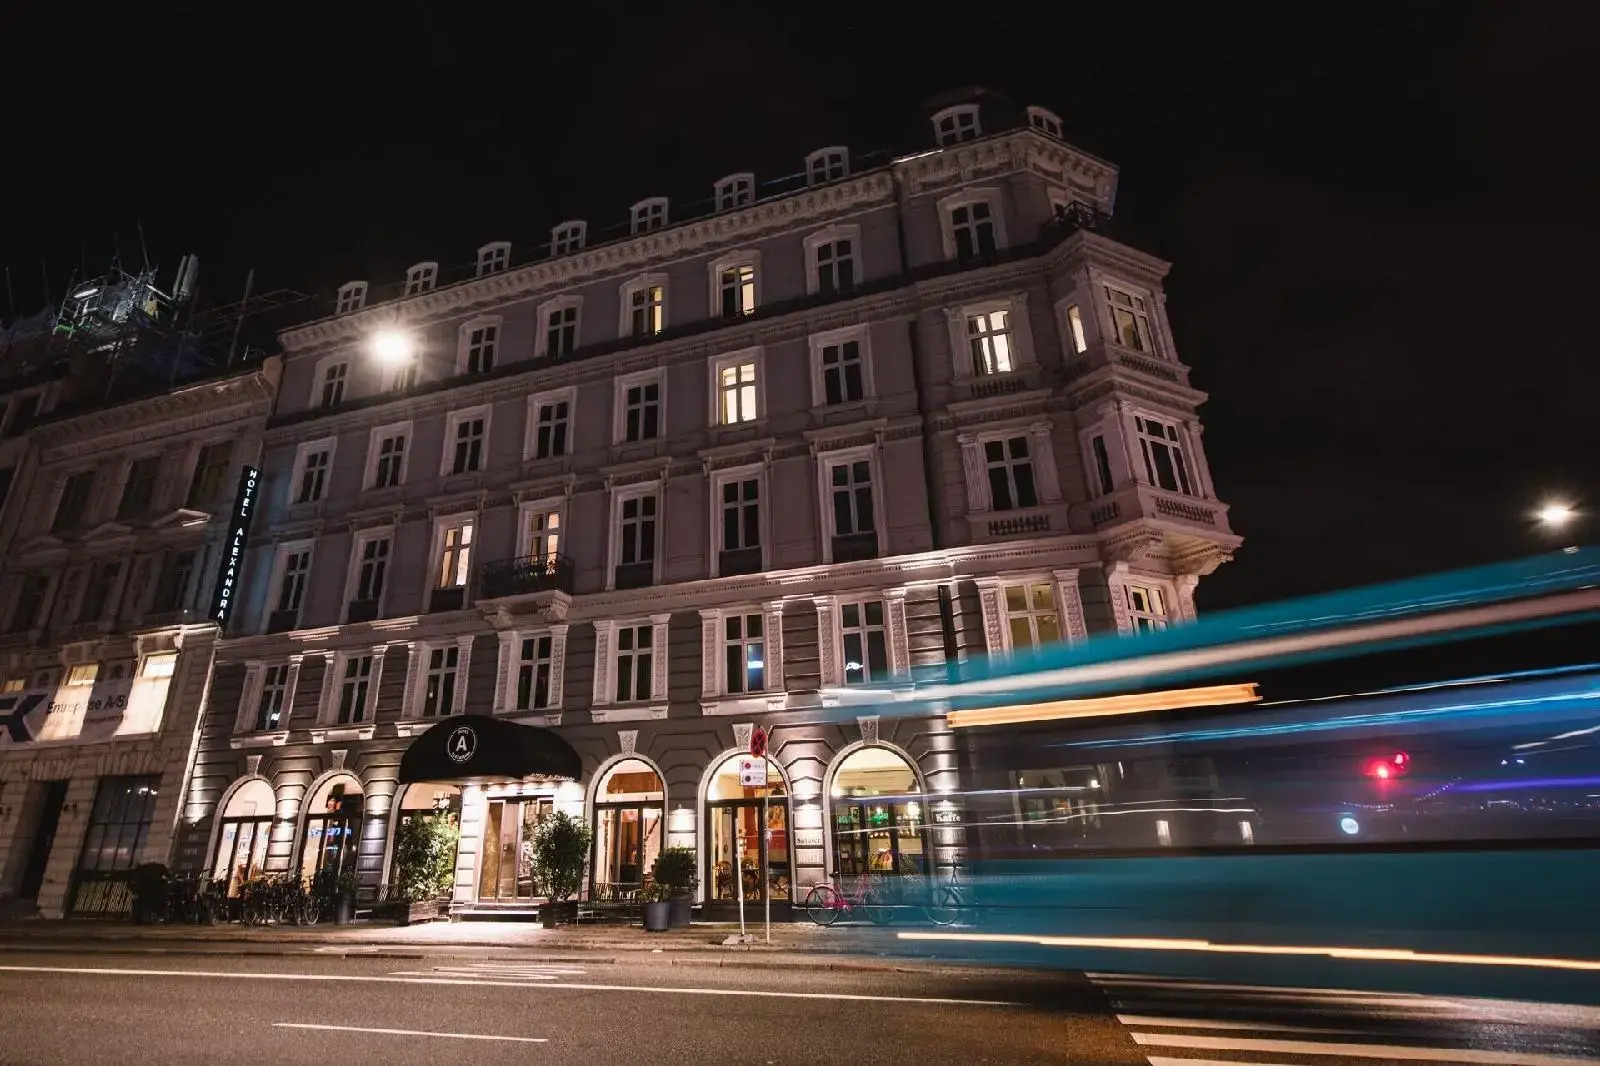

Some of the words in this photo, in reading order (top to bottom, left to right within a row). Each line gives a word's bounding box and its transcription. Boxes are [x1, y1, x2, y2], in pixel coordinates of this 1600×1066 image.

[241, 470, 258, 517] HOTEL
[217, 527, 243, 620] ALEXANDRA
[47, 699, 102, 714] Entrepse
[104, 695, 126, 711] A/S
[455, 735, 468, 751] A
